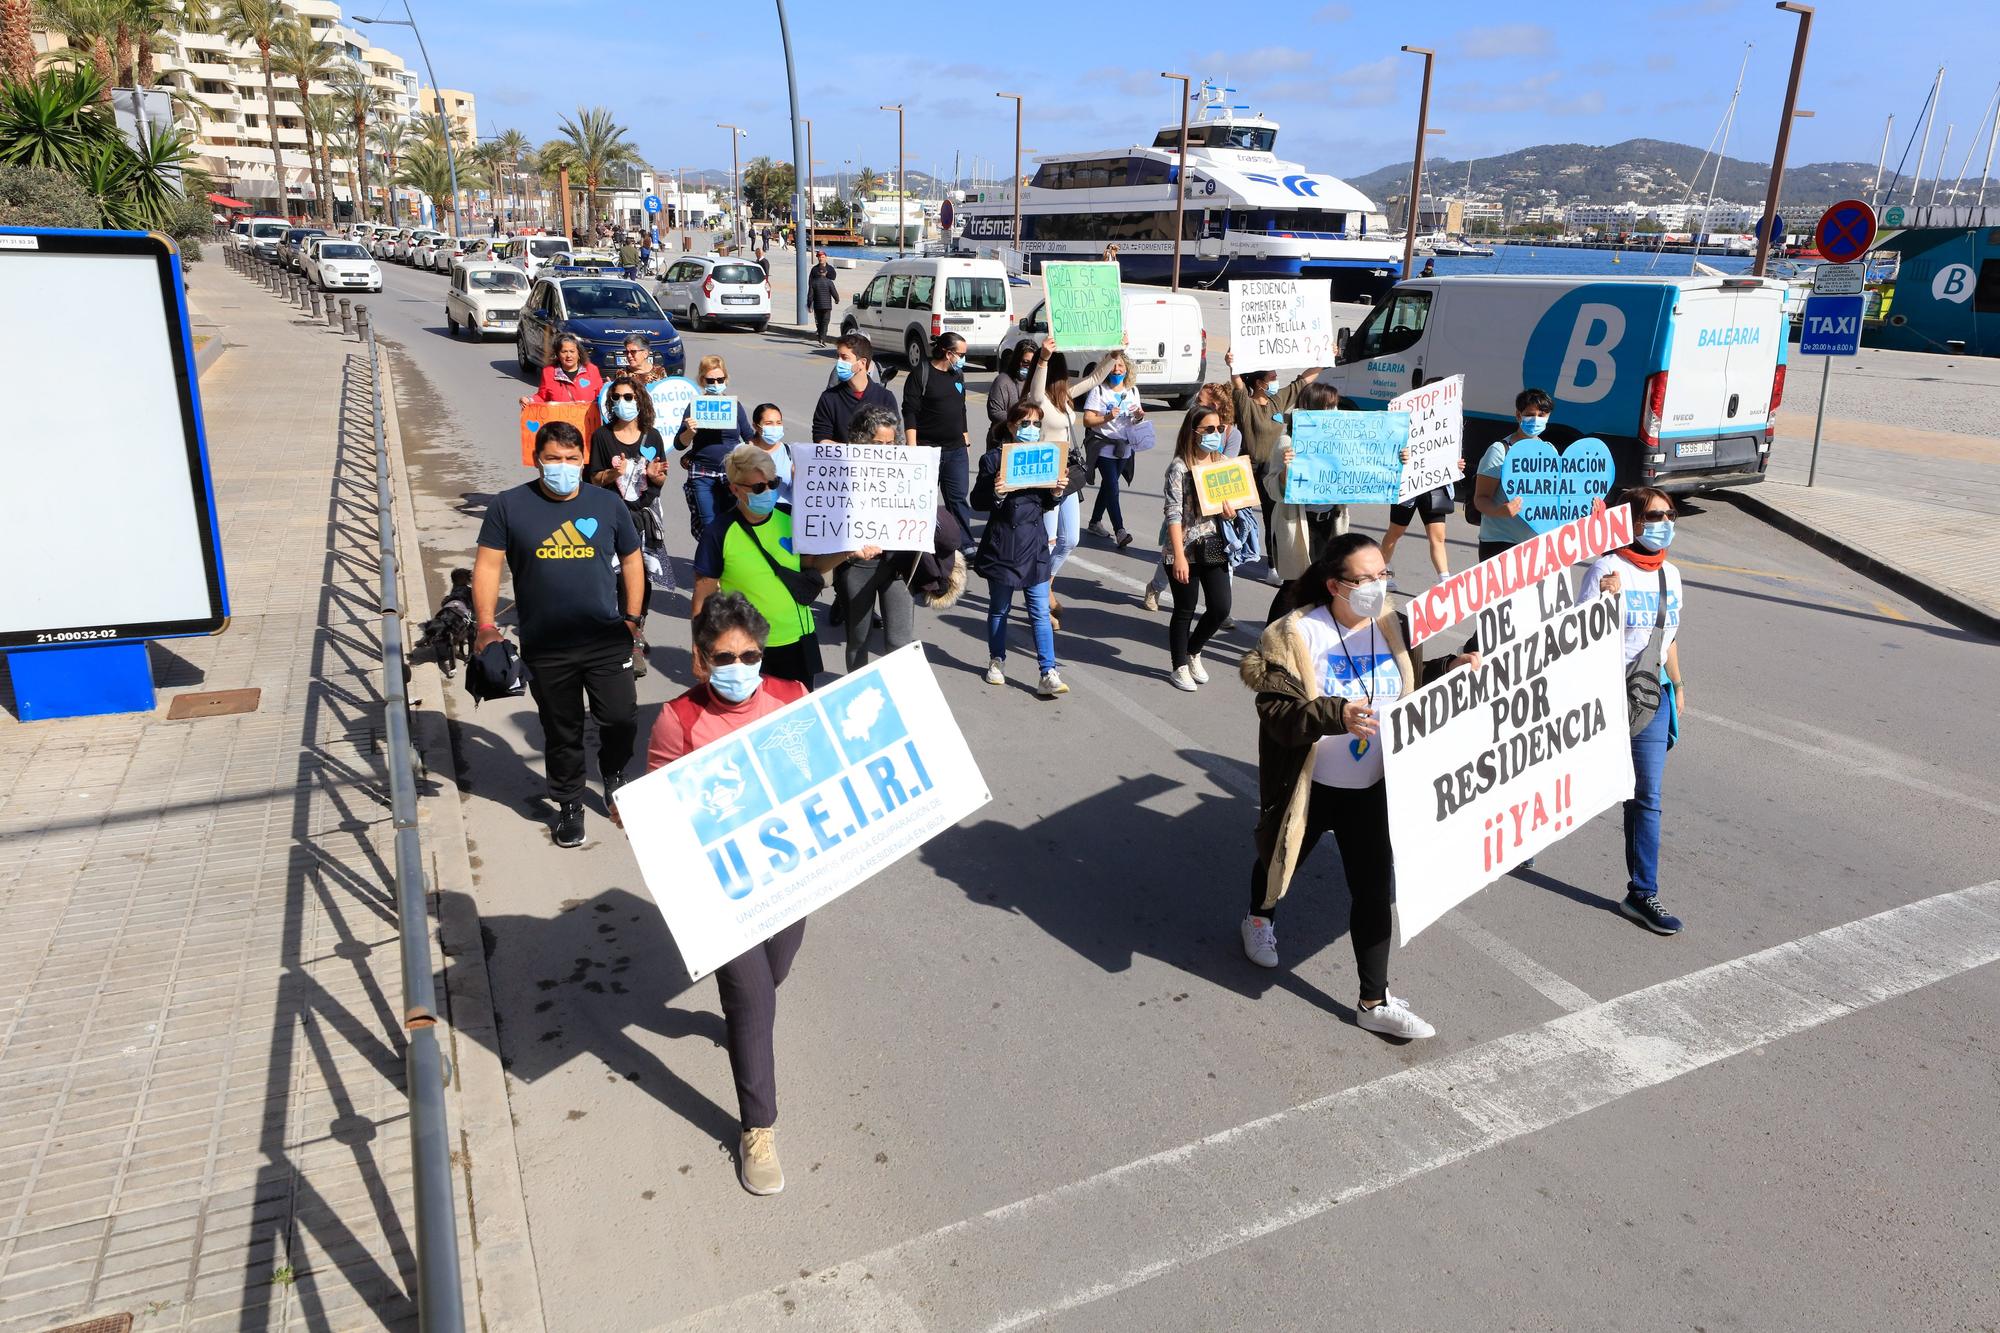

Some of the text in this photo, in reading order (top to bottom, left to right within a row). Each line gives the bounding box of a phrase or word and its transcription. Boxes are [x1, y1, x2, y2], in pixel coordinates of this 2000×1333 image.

[1026, 242, 1046, 251] FERRY
[1048, 242, 1055, 251] 30
[1056, 243, 1066, 251] min
[1080, 267, 1096, 286] SE
[1944, 268, 1967, 295] B
[1241, 281, 1297, 296] RESIDENCIA
[1058, 287, 1120, 309] QUEDA SIN
[1241, 300, 1287, 312] FORMENTERA
[1241, 311, 1280, 325] CANARIAS
[1808, 316, 1857, 335] TAXI
[1240, 325, 1265, 337] CEUTA
[1276, 319, 1306, 333] MELILLA
[1697, 327, 1760, 347] BALEARIA
[1554, 303, 1627, 404] B
[1803, 343, 1812, 351] De
[1367, 361, 1405, 374] BALEARIA
[1373, 379, 1397, 388] Maletas
[1370, 389, 1398, 398] Luggage
[1406, 390, 1440, 414] STOP
[1424, 409, 1435, 421] LA
[1673, 413, 1694, 422] IVECO
[1321, 419, 1366, 430] RECORTES
[1371, 419, 1383, 430] EN
[1411, 418, 1448, 438] GA DE
[1323, 430, 1394, 440] SANIDAD Y
[815, 444, 908, 462] RESIDENCIA
[1408, 434, 1455, 457] RSONAL
[1680, 443, 1698, 454] 5596
[1413, 458, 1425, 471] DE
[808, 466, 905, 479] FORMENTERA
[806, 478, 887, 492] CANARIAS
[1314, 485, 1332, 495] POR
[1506, 475, 1608, 495] SALARIAL CON
[805, 496, 854, 509] CEUTA
[871, 494, 916, 509] MELILLA
[897, 519, 928, 542] ???
[535, 544, 595, 559] adidas
[1409, 499, 1632, 648] ACTUALIZACIÓN
[1479, 571, 1575, 659] DE LA
[36, 629, 118, 643] 21-00032-02
[1490, 676, 1551, 743] POR
[1434, 697, 1606, 822] RESIDENCIA
[706, 739, 934, 900] U.S.E.I.R.I
[770, 890, 786, 906] DE
[840, 845, 861, 865] POR
